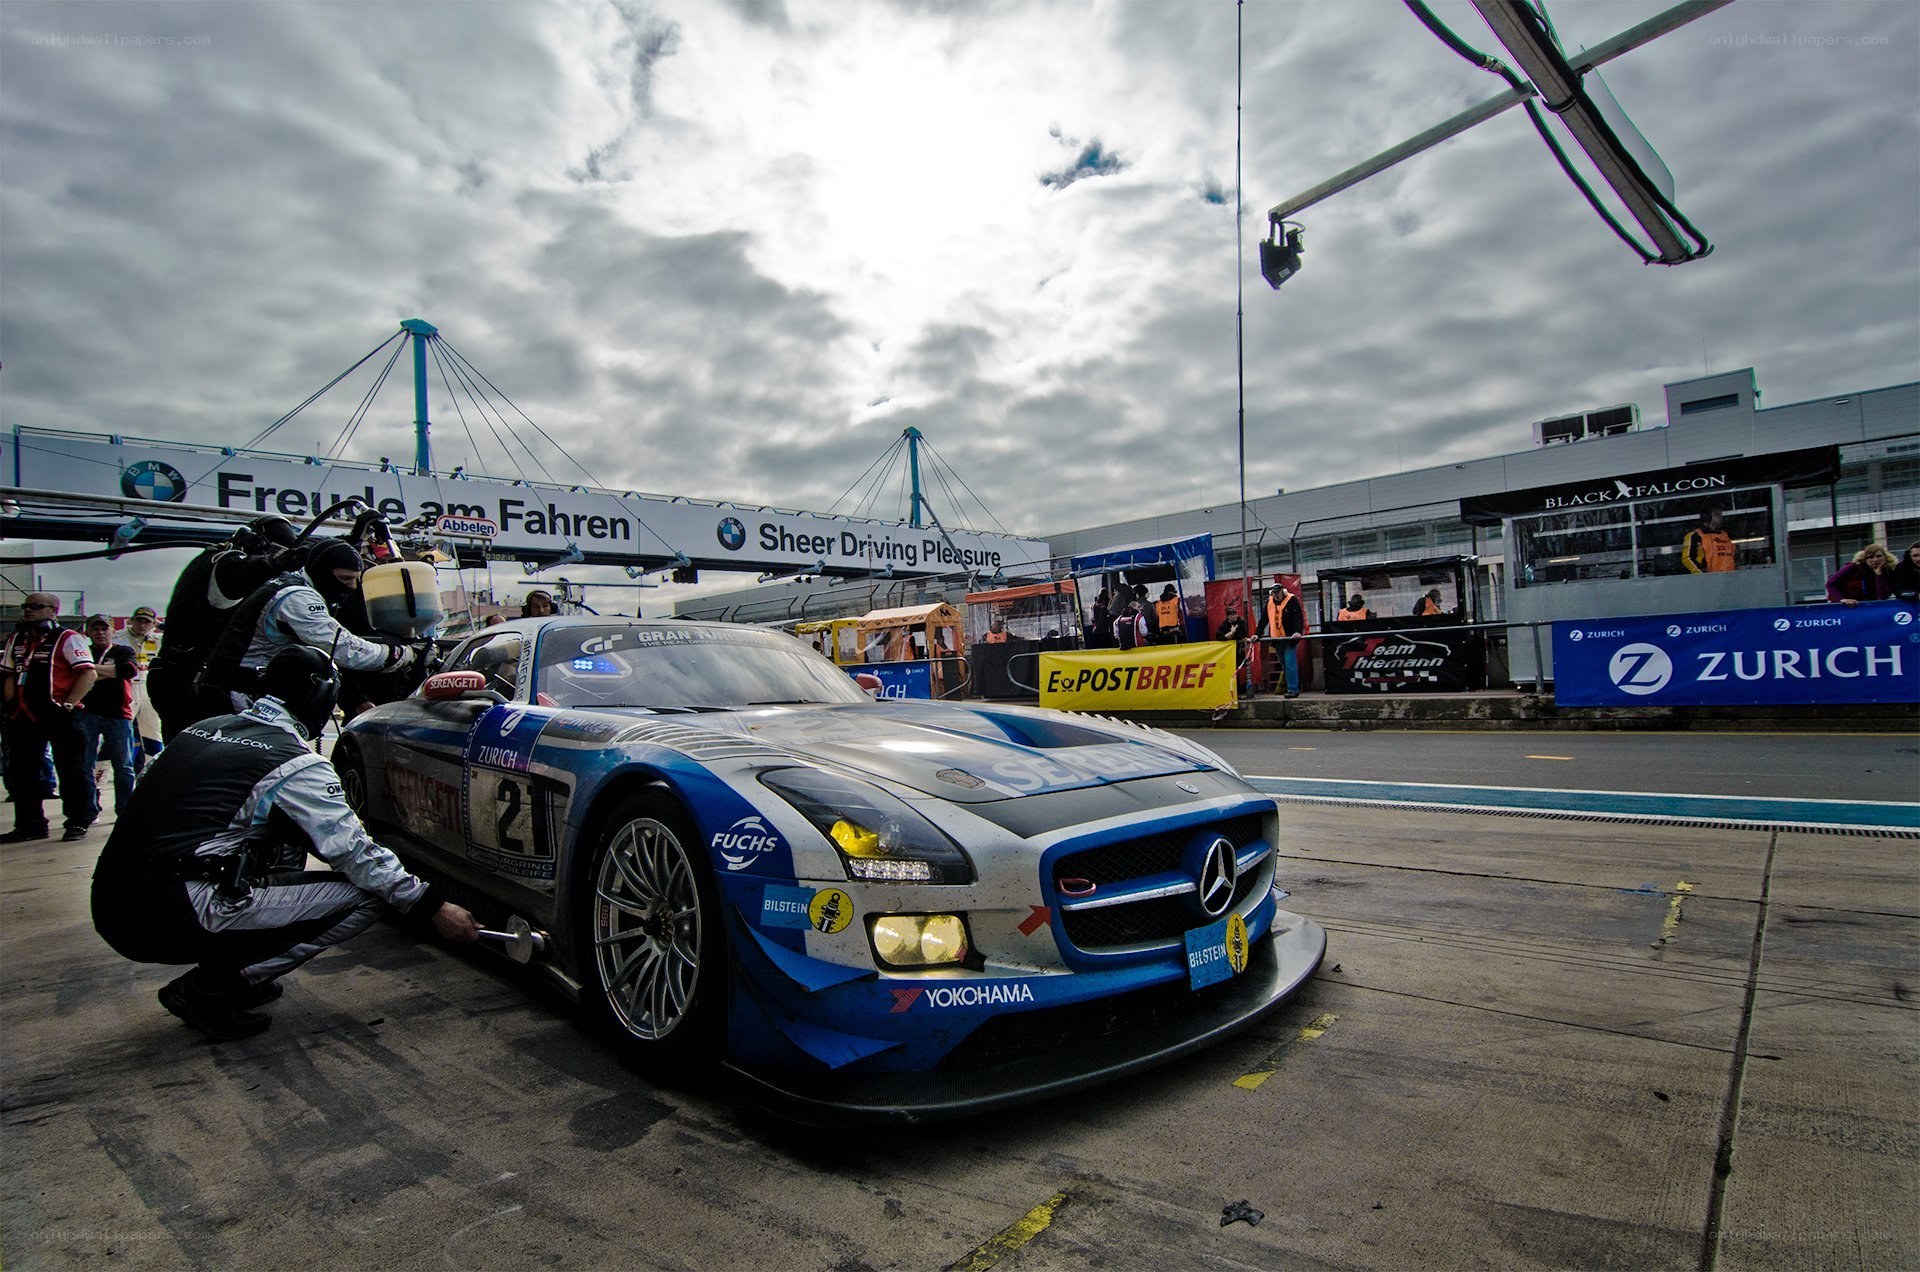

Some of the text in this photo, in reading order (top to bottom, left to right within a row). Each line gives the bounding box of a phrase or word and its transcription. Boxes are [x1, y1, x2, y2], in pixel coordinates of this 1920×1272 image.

[128, 462, 181, 482] BMW
[1545, 475, 1726, 509] BLACK FALCON
[218, 472, 630, 540] Freude am Fahren
[442, 519, 495, 534] Abbelen
[759, 523, 1001, 567] Sheer Driving Pleasure
[1686, 625, 1727, 634] ZURICH
[1795, 618, 1842, 628] ZURICH
[638, 631, 691, 642] GRAN
[1587, 630, 1625, 639] ZURICH
[1363, 637, 1417, 657] Team
[1343, 650, 1445, 670] Thiemann
[1696, 645, 1903, 681] ZURICH
[430, 677, 479, 689] SERENGETI
[478, 745, 518, 769] ZURICH
[327, 785, 343, 795] OM
[711, 833, 778, 853] FUCHS
[764, 899, 808, 914] BILSTEIN
[1188, 943, 1227, 968] BILSTEIN
[926, 983, 1034, 1008] YOKOHAMA
